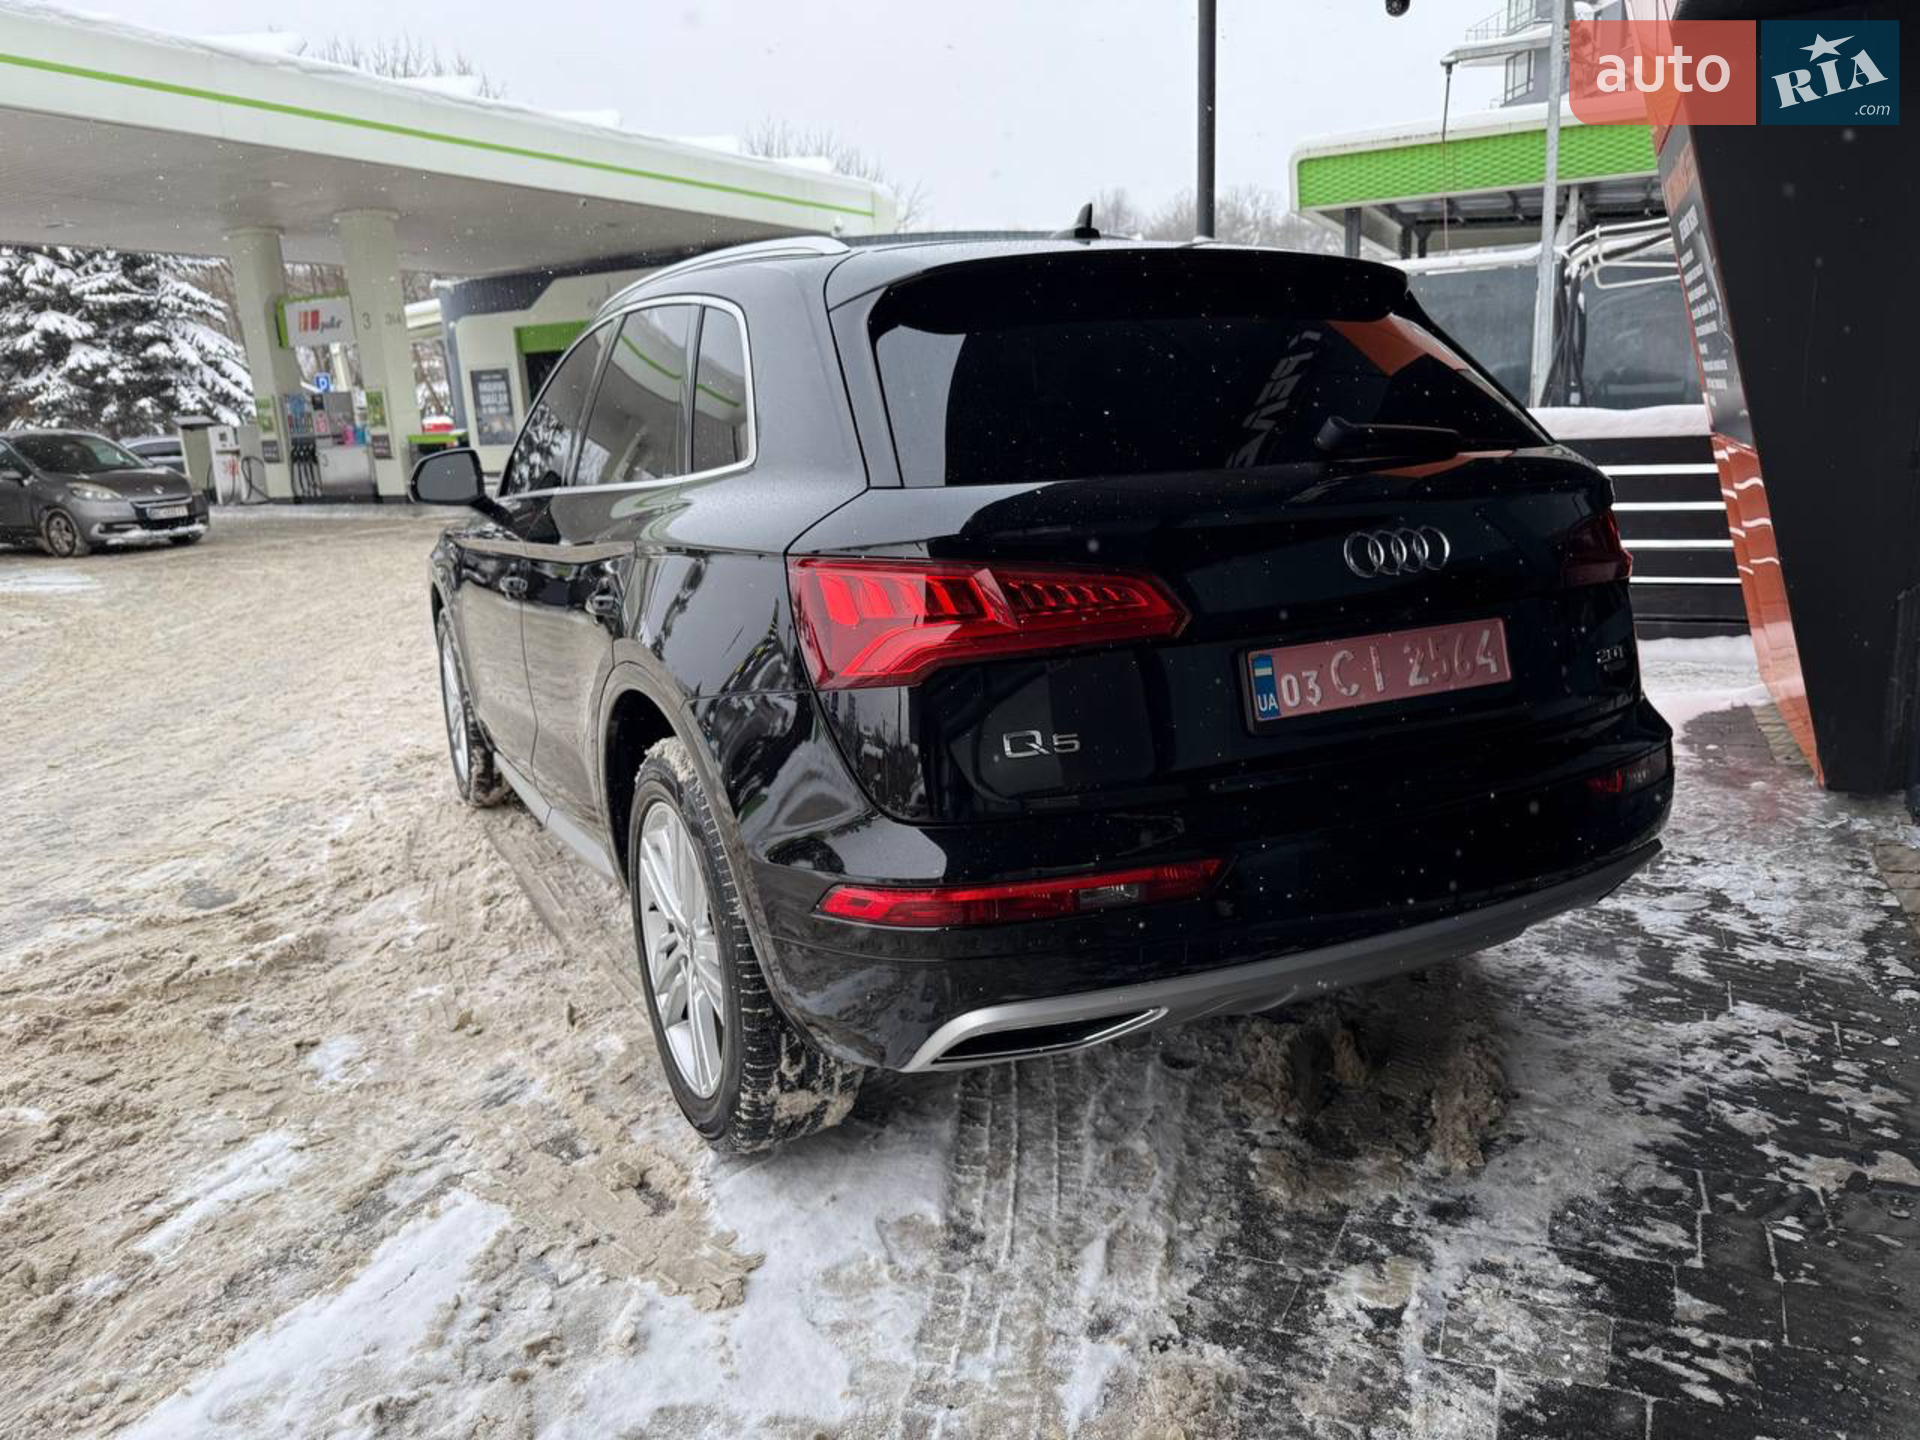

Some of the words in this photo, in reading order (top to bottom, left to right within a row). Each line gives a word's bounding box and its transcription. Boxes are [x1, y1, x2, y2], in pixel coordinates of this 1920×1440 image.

[1281, 670, 1322, 708] 03
[1403, 629, 1498, 687] 2564
[1257, 693, 1278, 712] UA
[1003, 729, 1081, 759] Q5
